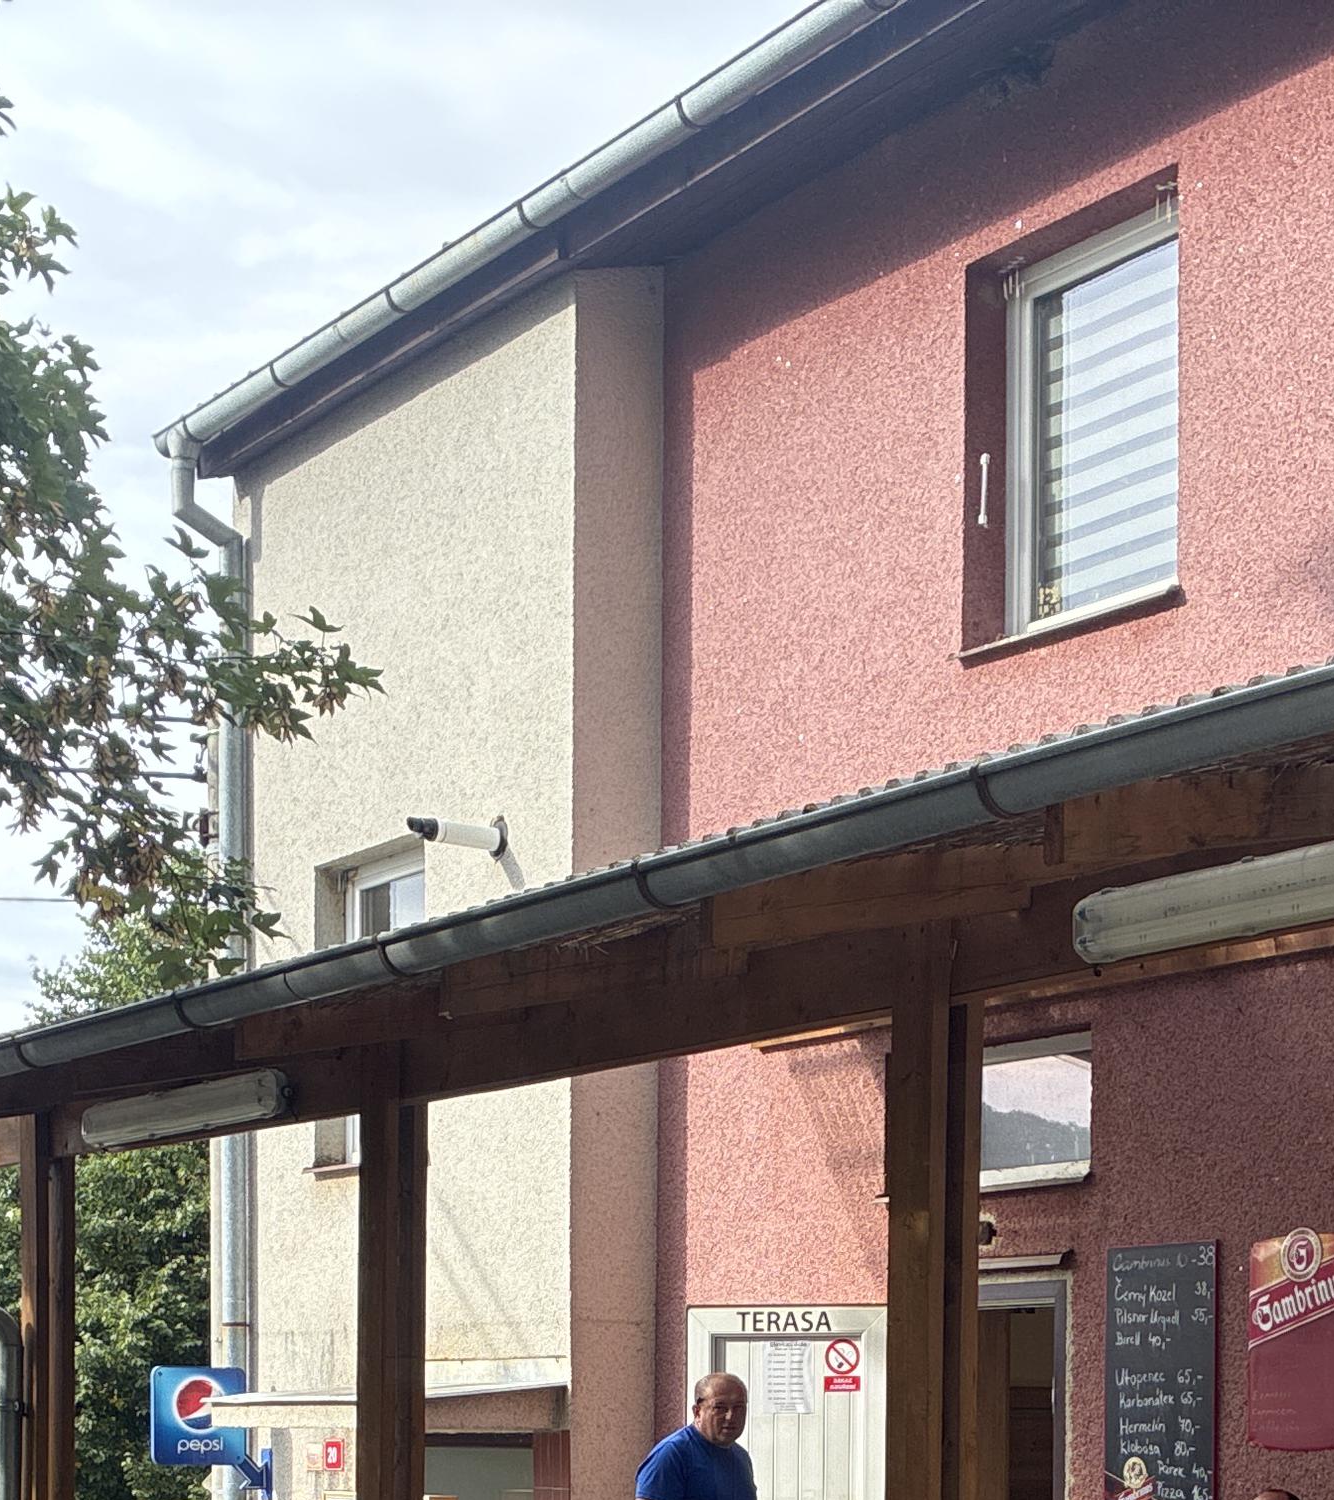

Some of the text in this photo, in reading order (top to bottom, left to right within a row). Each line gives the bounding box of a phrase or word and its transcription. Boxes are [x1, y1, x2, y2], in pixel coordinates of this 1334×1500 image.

[1114, 1276, 1147, 1308] Černý
[1149, 1283, 1176, 1302] Kozel
[737, 1311, 832, 1332] TERASA
[1115, 1368, 1203, 1390] Utopenec 65,-
[1119, 1388, 1203, 1409] Karbanátek 65,-
[1119, 1416, 1165, 1435] Hermelín
[177, 1436, 223, 1454] pepsi
[327, 1446, 338, 1464] 20
[1157, 1458, 1186, 1478] Párek
[1156, 1481, 1186, 1499] Pizza
